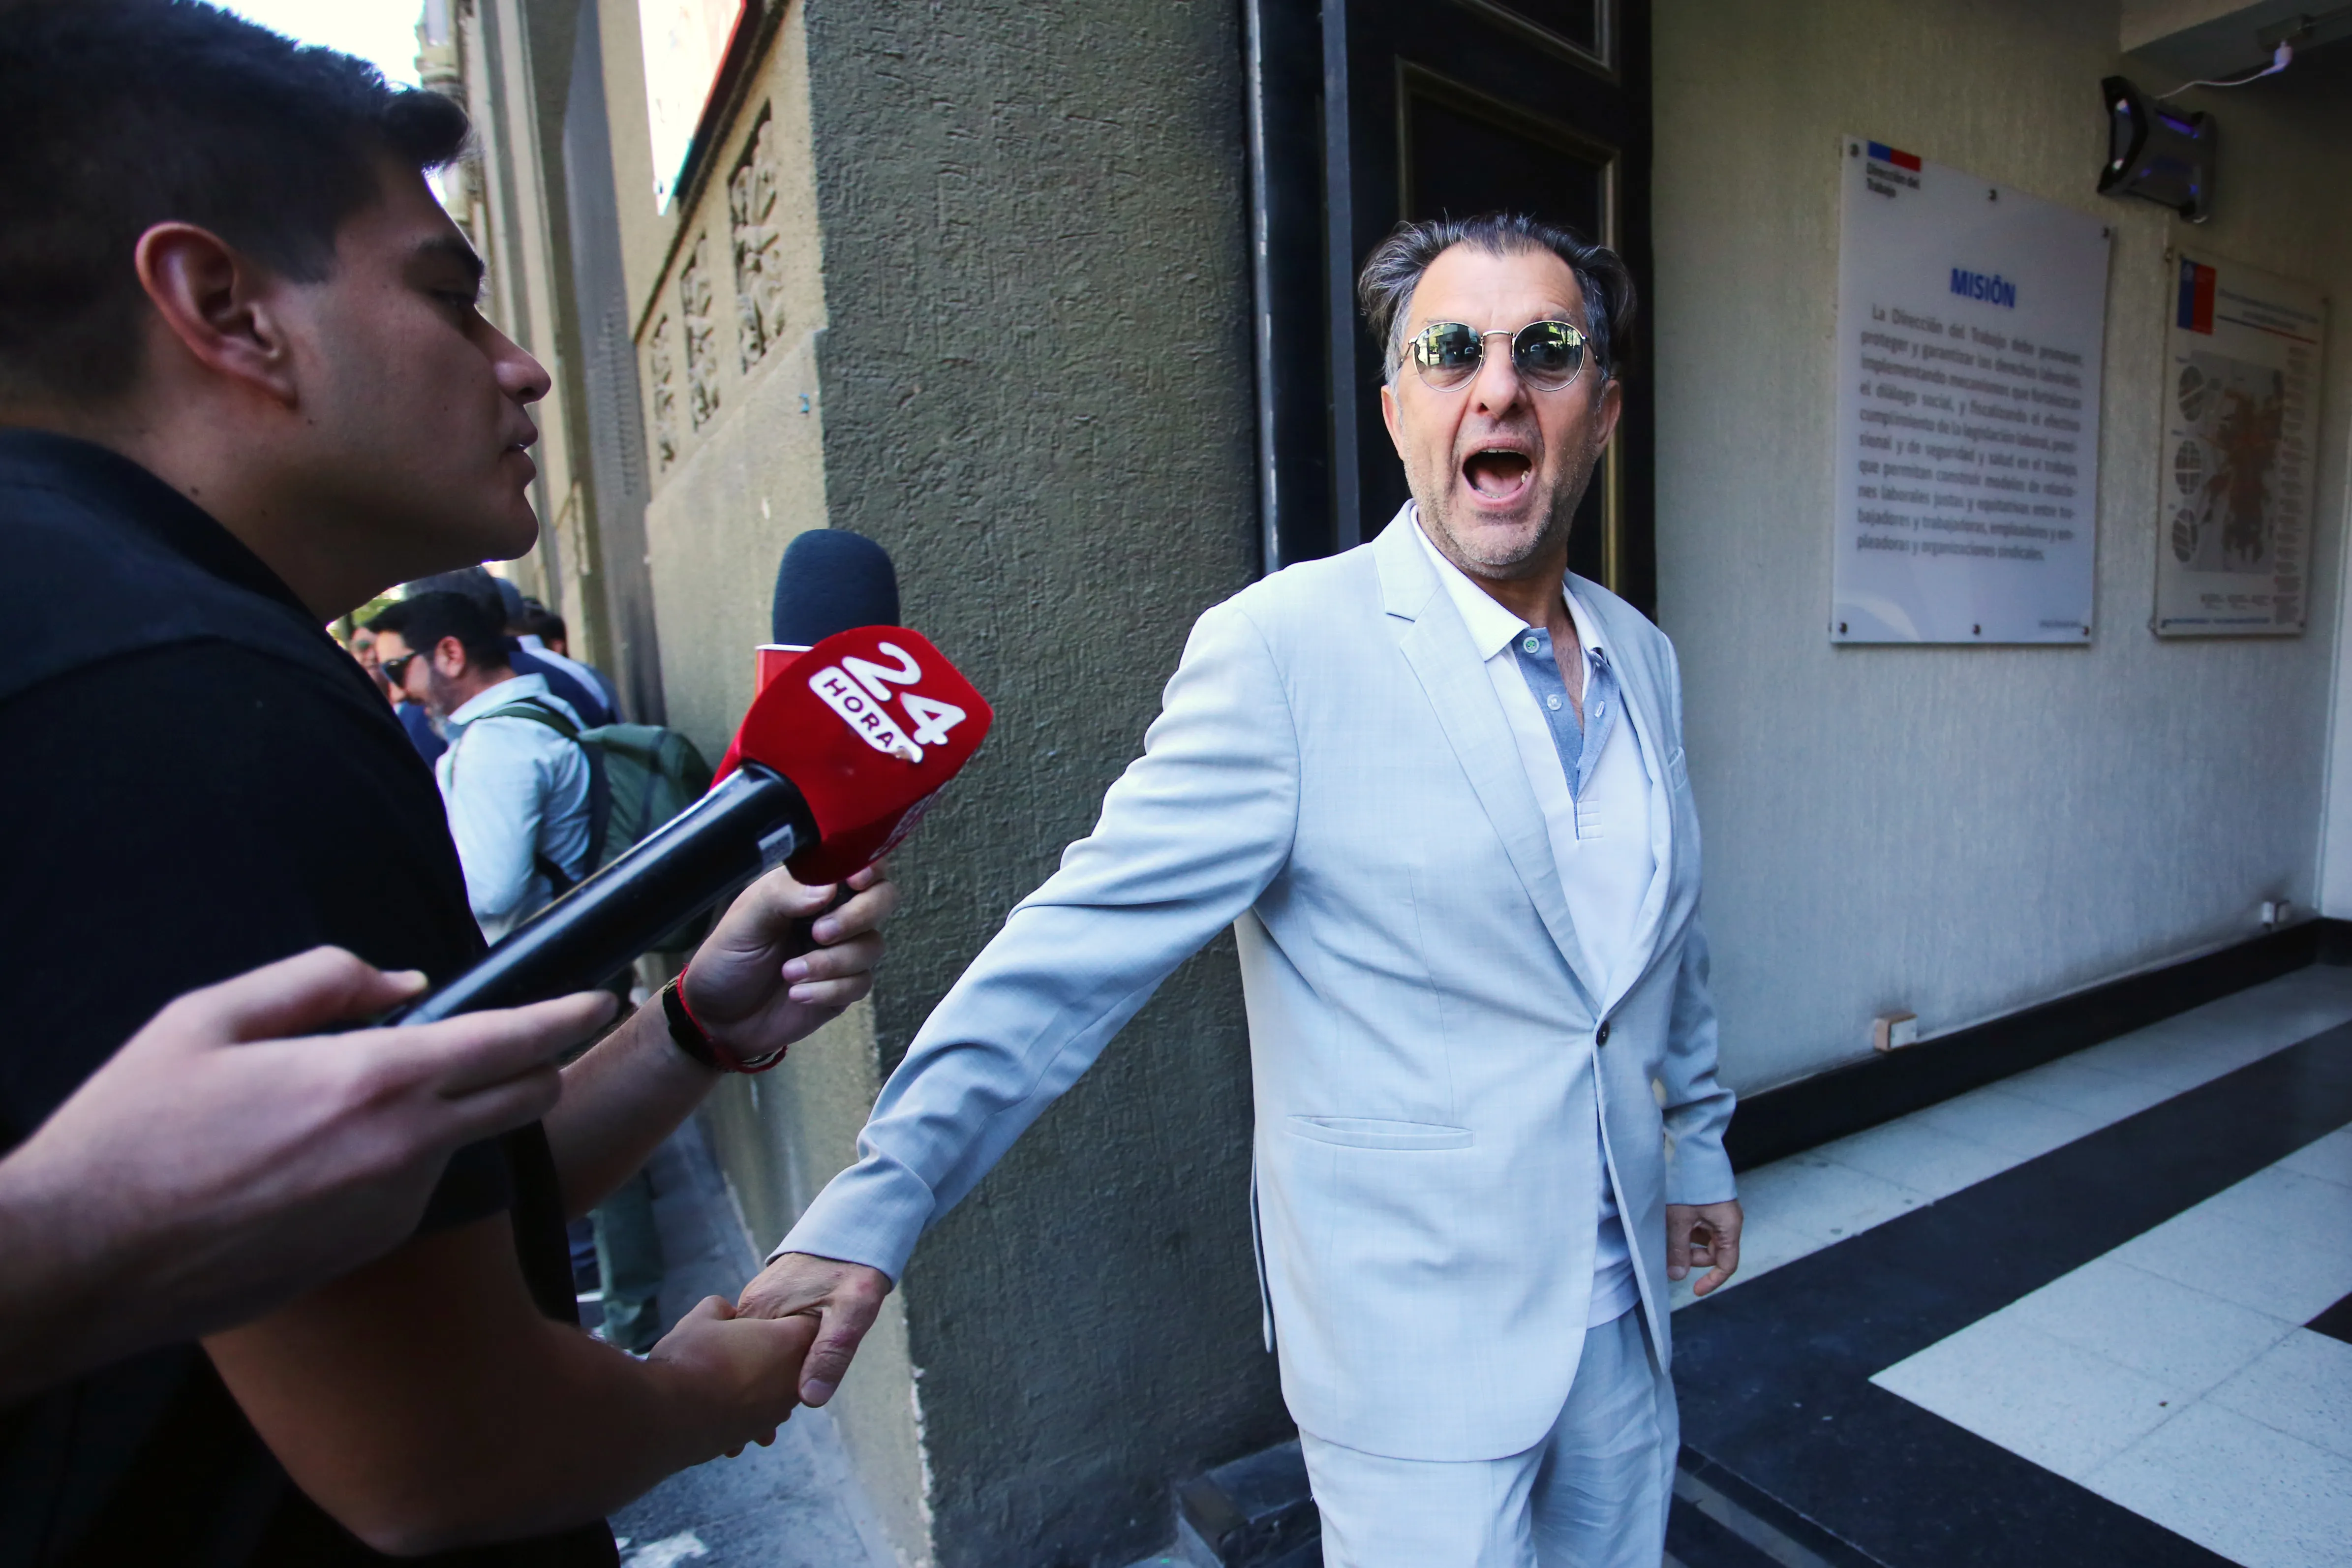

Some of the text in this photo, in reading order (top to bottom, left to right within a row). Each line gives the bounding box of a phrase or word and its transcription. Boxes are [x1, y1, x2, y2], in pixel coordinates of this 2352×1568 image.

[1950, 268, 2016, 308] MISIÓN
[824, 677, 909, 759] HORA
[842, 642, 966, 744] 24
